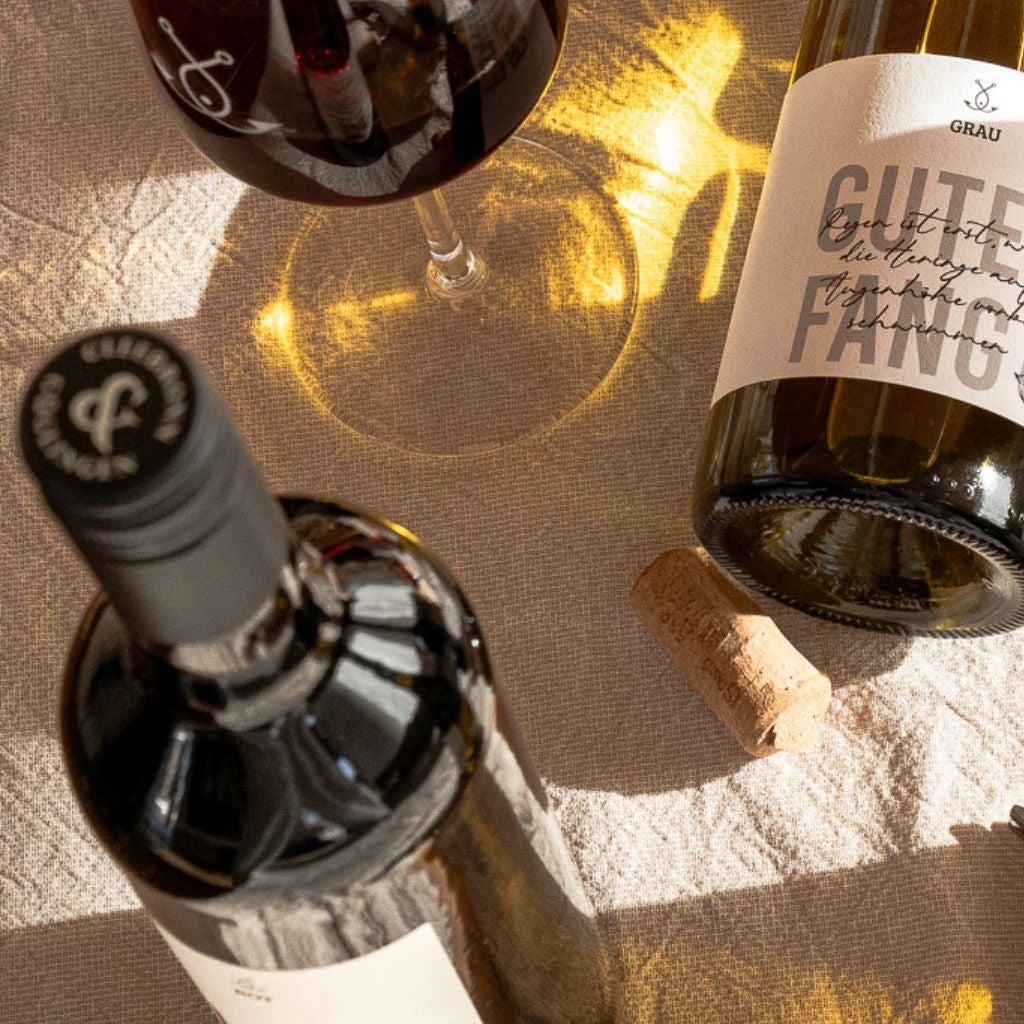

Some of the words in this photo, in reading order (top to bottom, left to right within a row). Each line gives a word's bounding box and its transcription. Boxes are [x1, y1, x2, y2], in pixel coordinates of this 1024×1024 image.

[950, 120, 1002, 142] GRAU
[900, 207, 952, 234] ist
[838, 240, 878, 263] die
[788, 274, 1010, 391] FANG
